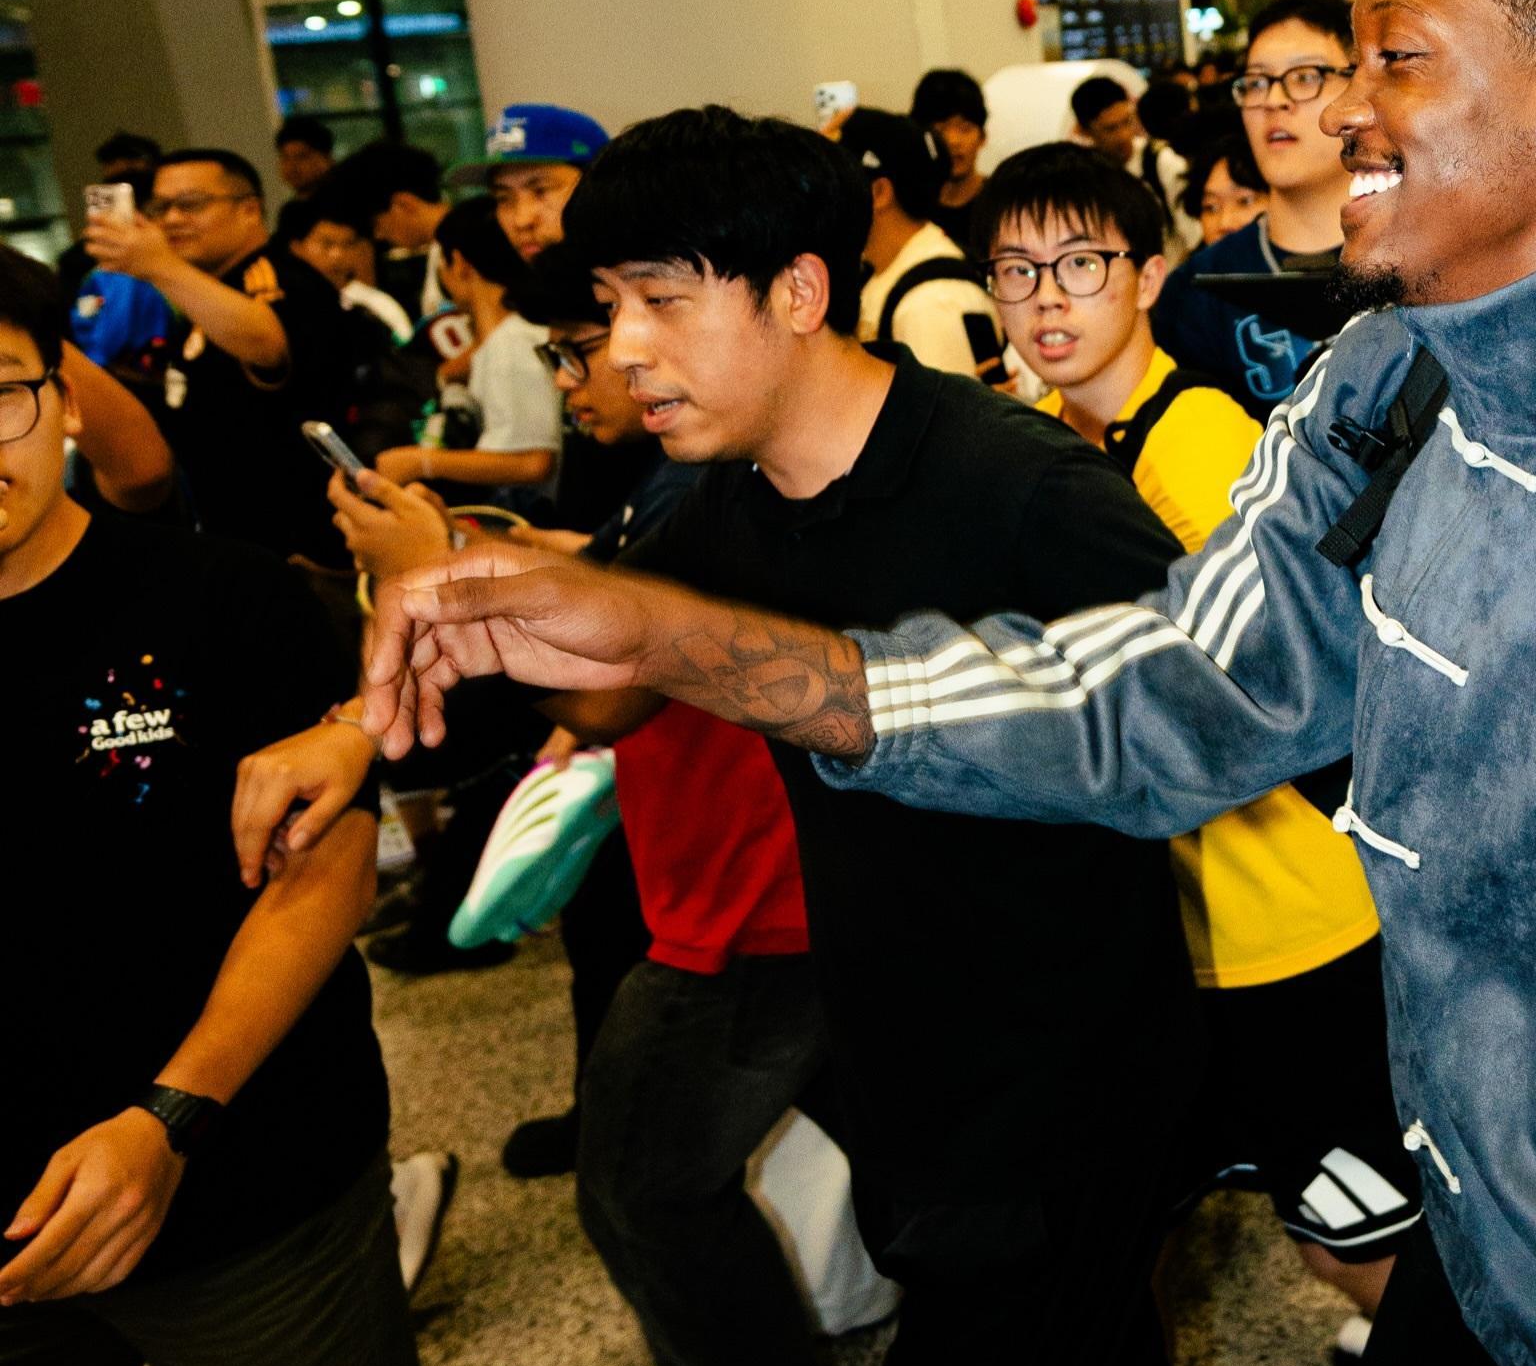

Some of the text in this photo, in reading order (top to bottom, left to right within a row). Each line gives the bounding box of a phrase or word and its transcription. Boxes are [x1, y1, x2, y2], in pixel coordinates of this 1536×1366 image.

[90, 708, 171, 736] a few
[137, 726, 174, 744] kids
